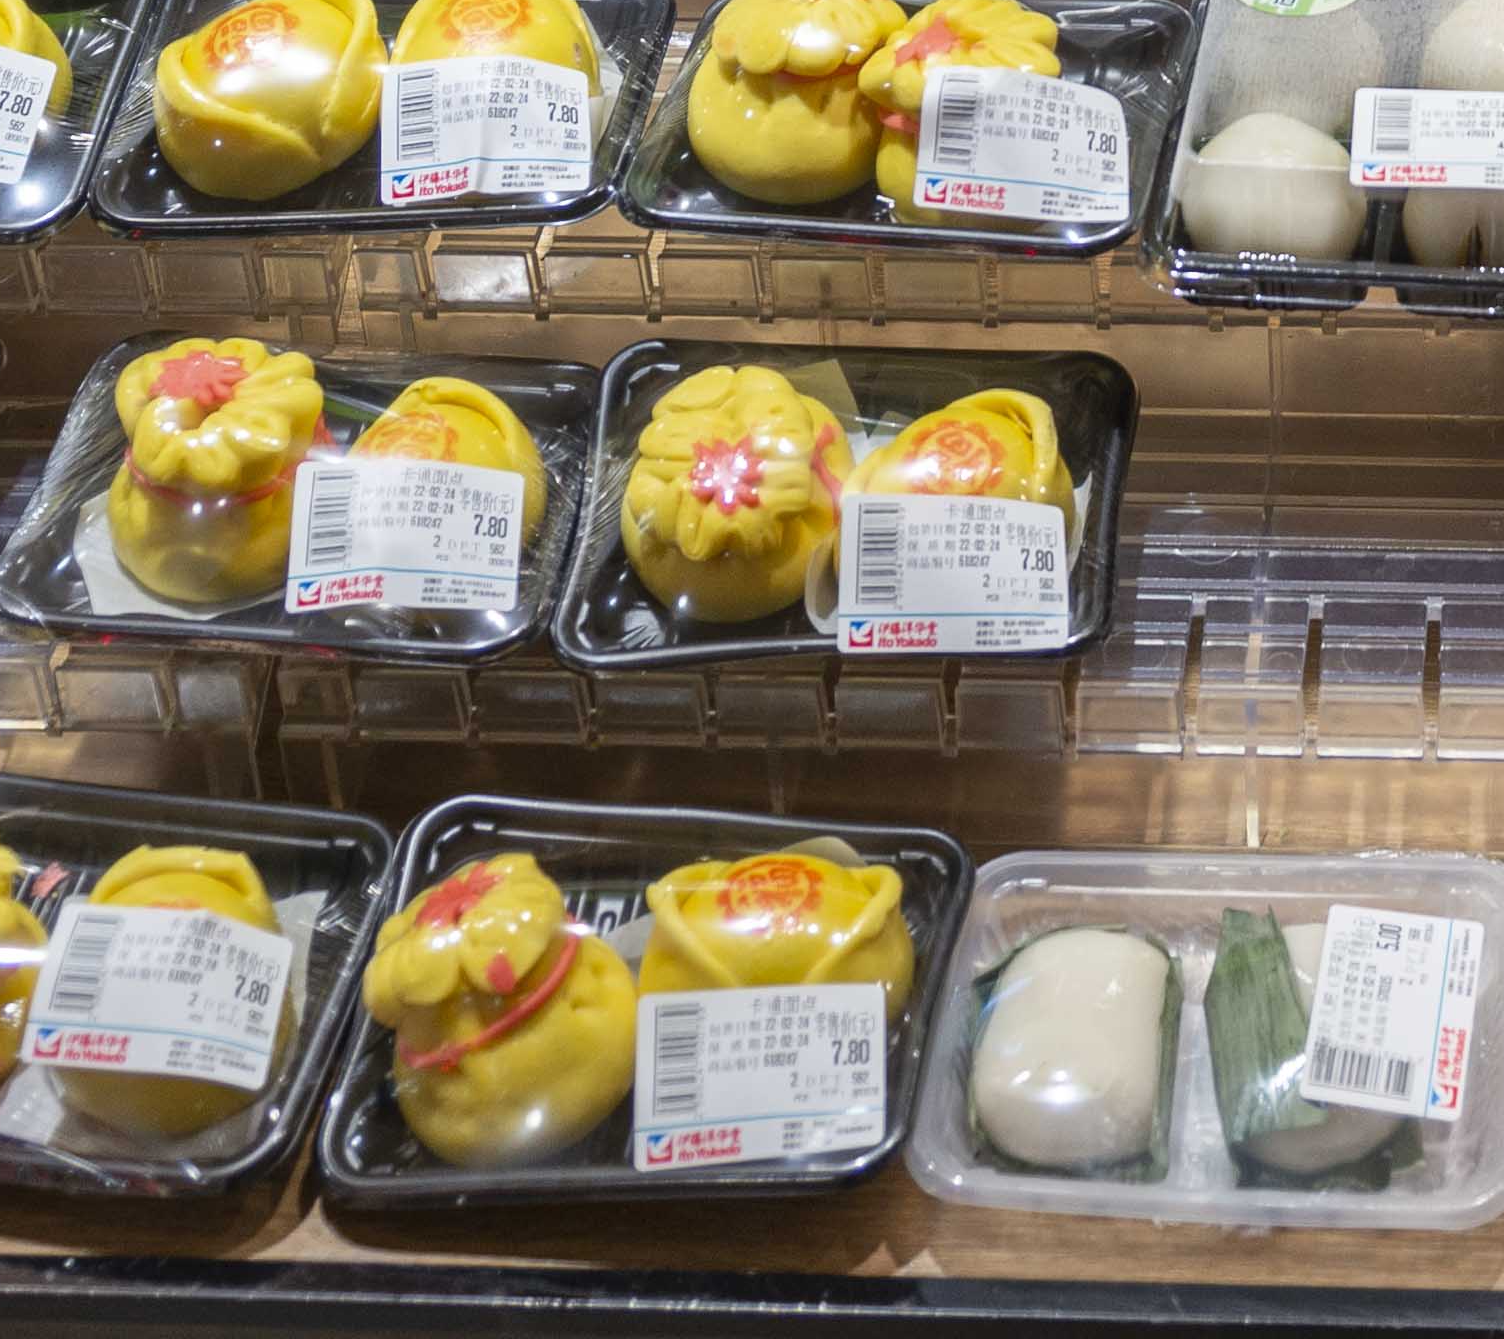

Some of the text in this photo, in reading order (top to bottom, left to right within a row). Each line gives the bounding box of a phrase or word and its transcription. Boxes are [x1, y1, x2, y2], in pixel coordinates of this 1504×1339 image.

[0, 89, 33, 115] 7.80
[547, 102, 579, 124] 7.80
[1087, 131, 1118, 154] 7.80
[473, 514, 508, 539] 7.80
[1019, 548, 1055, 572] 7.80
[896, 636, 938, 649] Yokado
[1377, 923, 1401, 953] 5.00
[234, 974, 271, 1006] 7.80
[830, 1040, 870, 1066] 7.80
